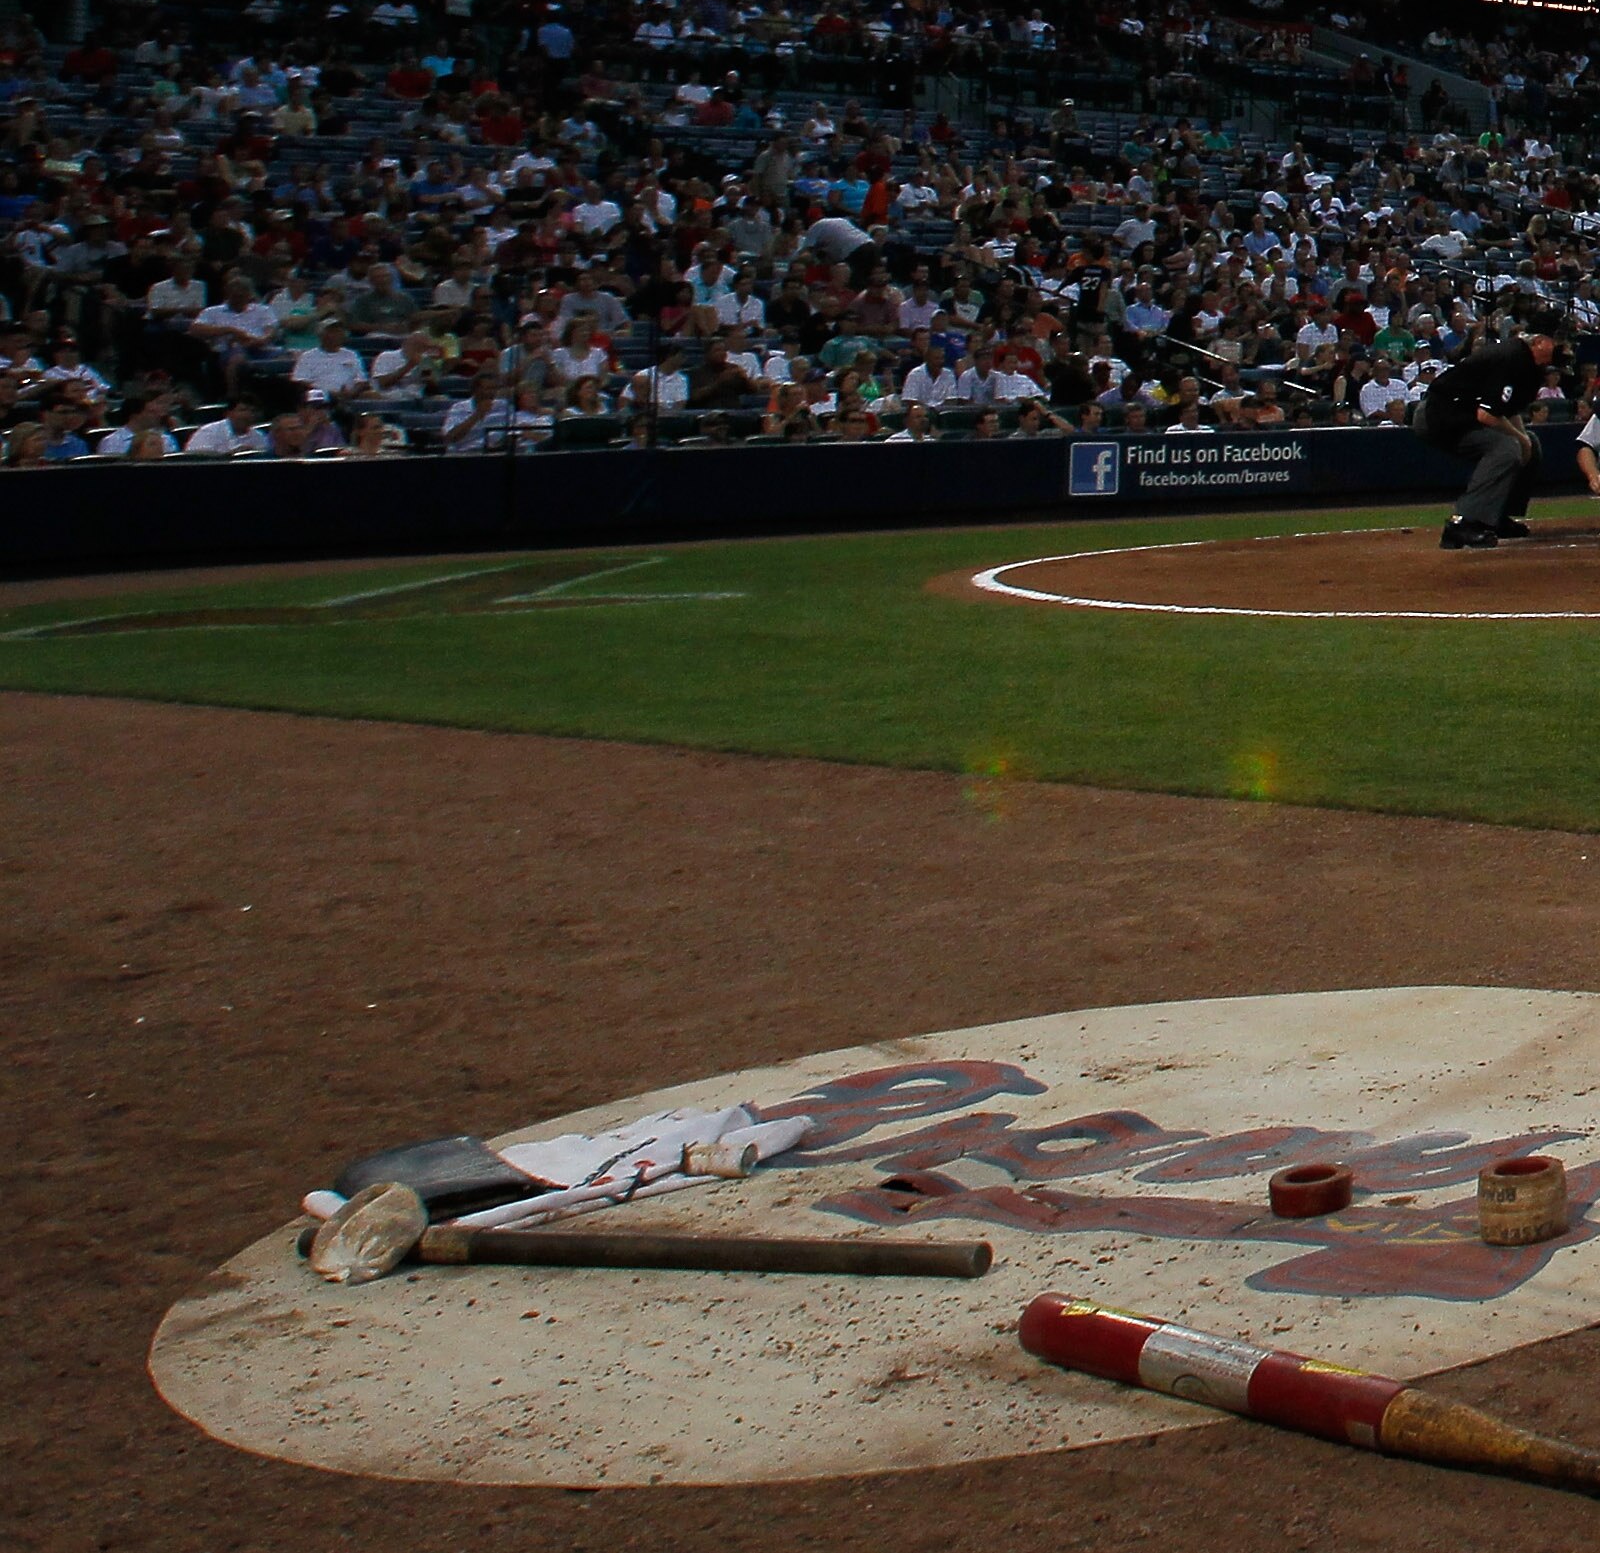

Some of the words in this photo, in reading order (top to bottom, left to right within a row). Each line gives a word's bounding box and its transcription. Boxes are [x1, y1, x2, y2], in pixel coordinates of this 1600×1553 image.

[1126, 445, 1166, 465] Find
[1170, 449, 1191, 464] us
[1196, 448, 1218, 463] on
[1139, 469, 1290, 487] facebook.com/braves
